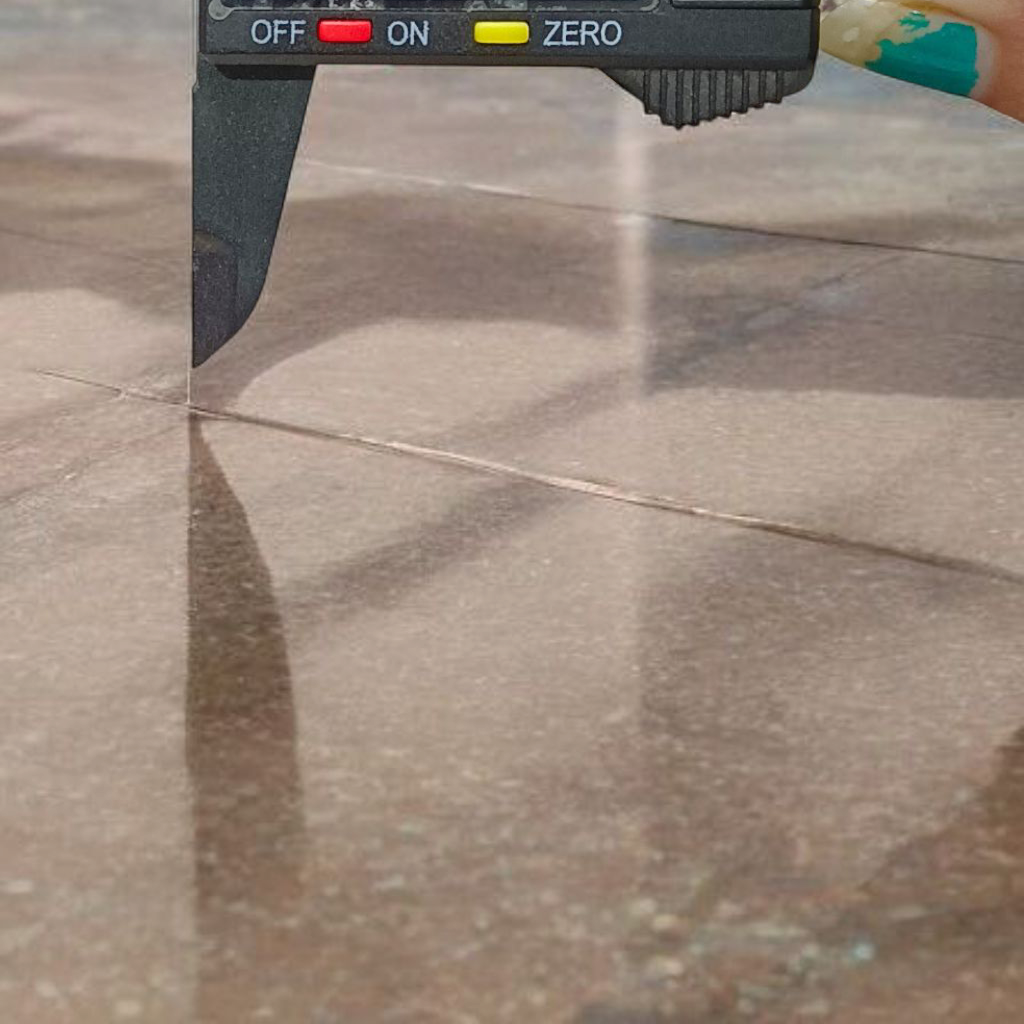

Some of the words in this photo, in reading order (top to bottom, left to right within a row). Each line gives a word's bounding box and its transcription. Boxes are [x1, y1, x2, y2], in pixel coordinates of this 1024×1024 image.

[250, 20, 306, 44] OFF
[388, 21, 430, 46] ON
[543, 20, 622, 46] ZERO
